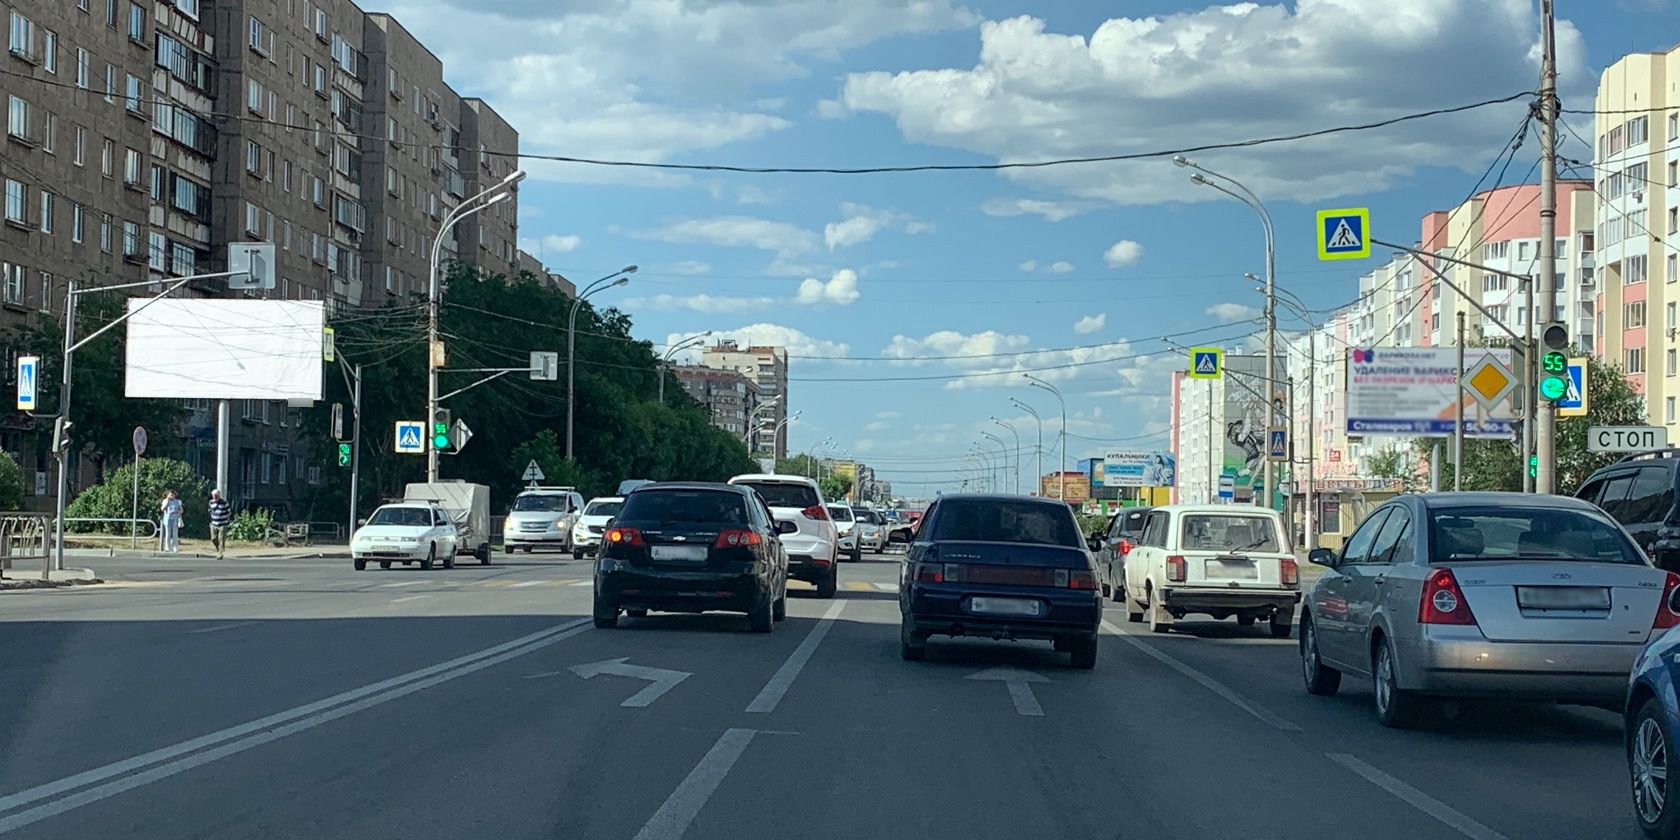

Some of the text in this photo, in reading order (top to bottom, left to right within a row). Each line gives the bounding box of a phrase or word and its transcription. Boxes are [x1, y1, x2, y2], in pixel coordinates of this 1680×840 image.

[1545, 355, 1563, 371] 55
[436, 424, 446, 433] 55
[1598, 431, 1654, 448] СТОП
